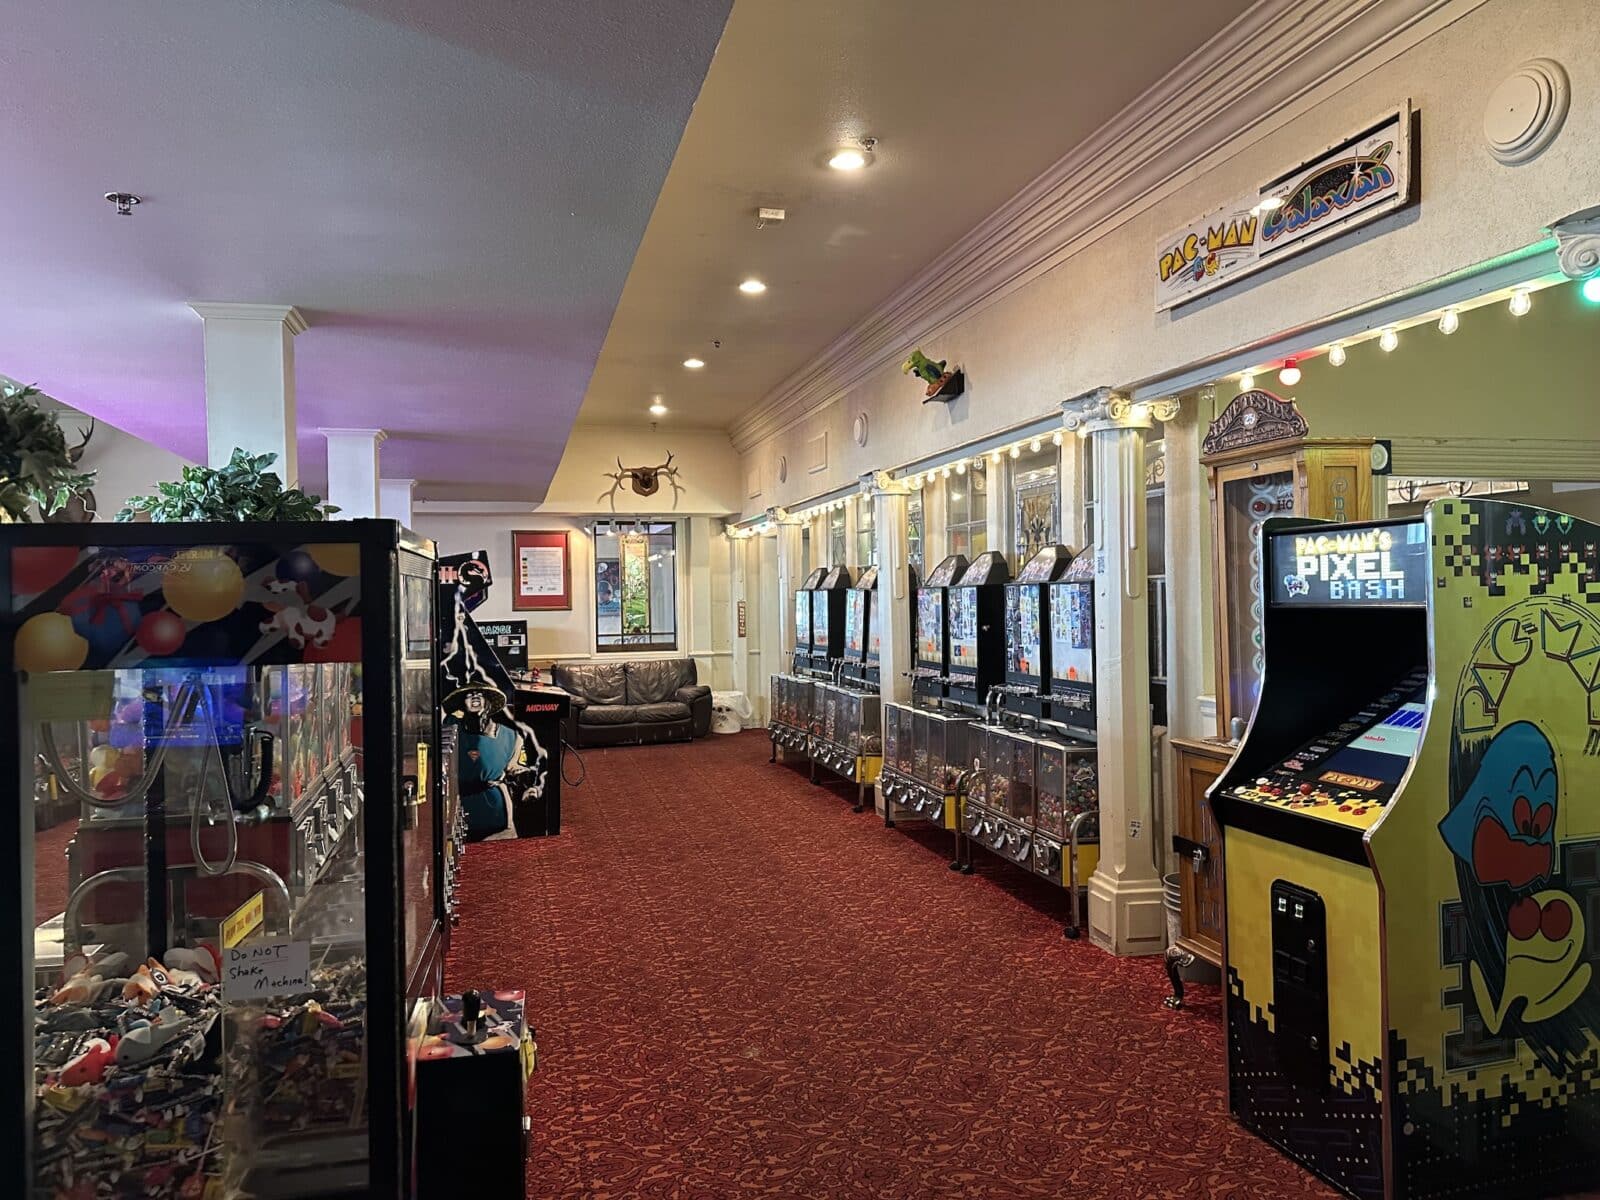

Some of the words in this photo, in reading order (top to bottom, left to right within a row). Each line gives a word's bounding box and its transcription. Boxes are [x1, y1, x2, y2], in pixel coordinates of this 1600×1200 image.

[1261, 163, 1395, 241] Galaxian
[1159, 215, 1257, 281] PAC-MAN
[1240, 393, 1293, 421] TESTER
[1295, 528, 1392, 555] PAC-MAN'S
[1297, 551, 1404, 580] PIXEL
[1330, 579, 1404, 599] BASH
[526, 703, 559, 712] MIDWAY
[231, 949, 247, 961] Do
[252, 944, 288, 958] NOT
[254, 969, 308, 990] Machine!
